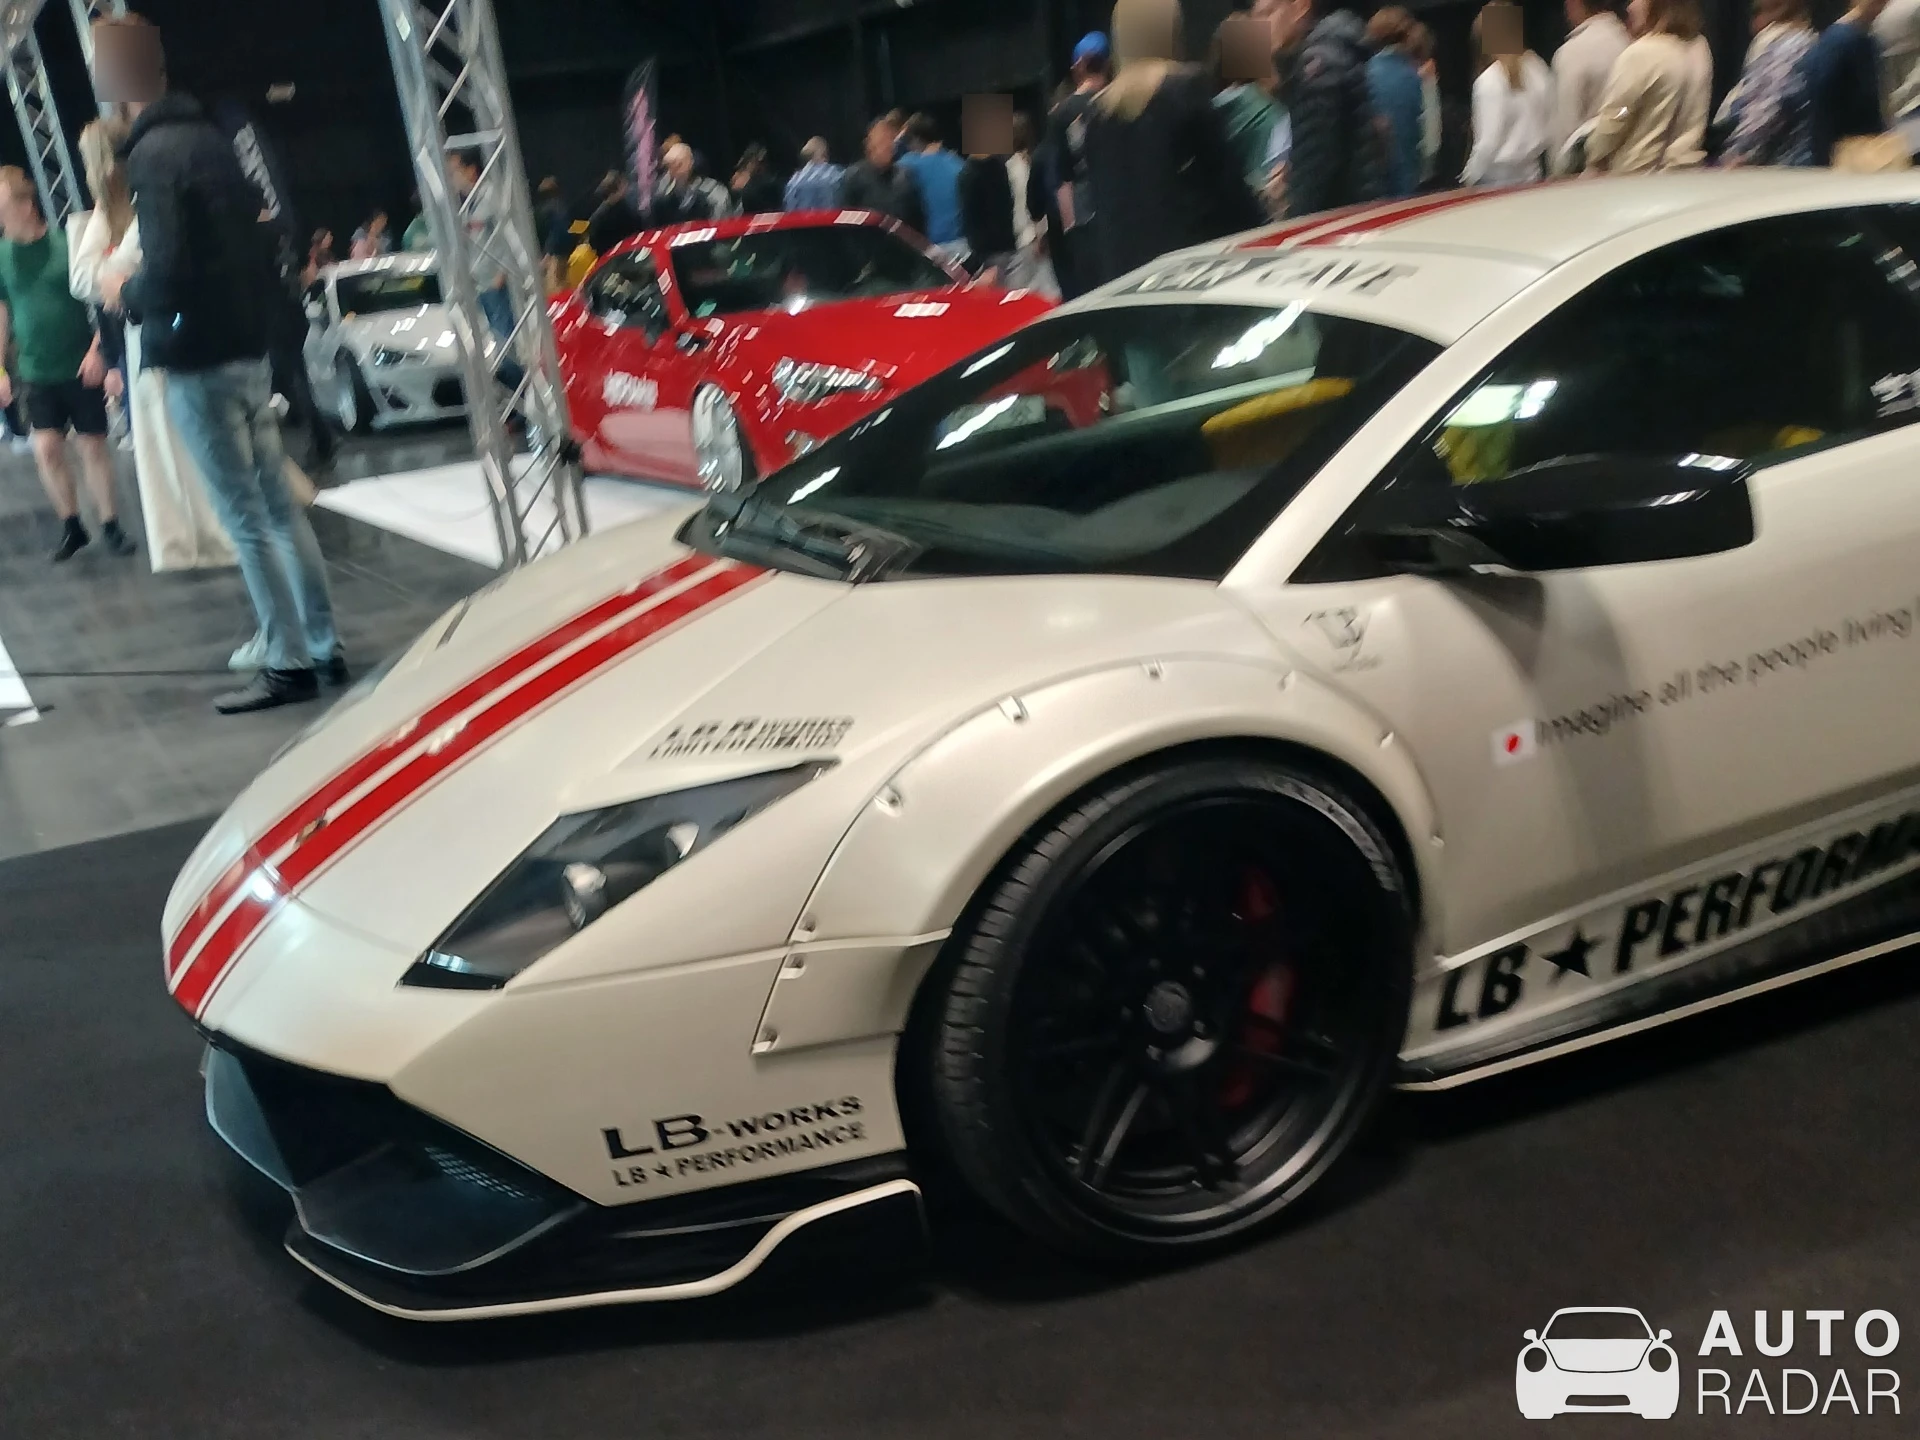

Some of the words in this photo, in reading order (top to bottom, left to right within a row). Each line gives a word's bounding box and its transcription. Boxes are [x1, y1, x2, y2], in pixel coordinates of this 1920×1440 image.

[1658, 671, 1692, 706] all
[1747, 629, 1839, 687] people
[1433, 941, 1532, 1031] LB
[612, 1165, 648, 1187] LB
[674, 1122, 866, 1176] PERFORMANCE
